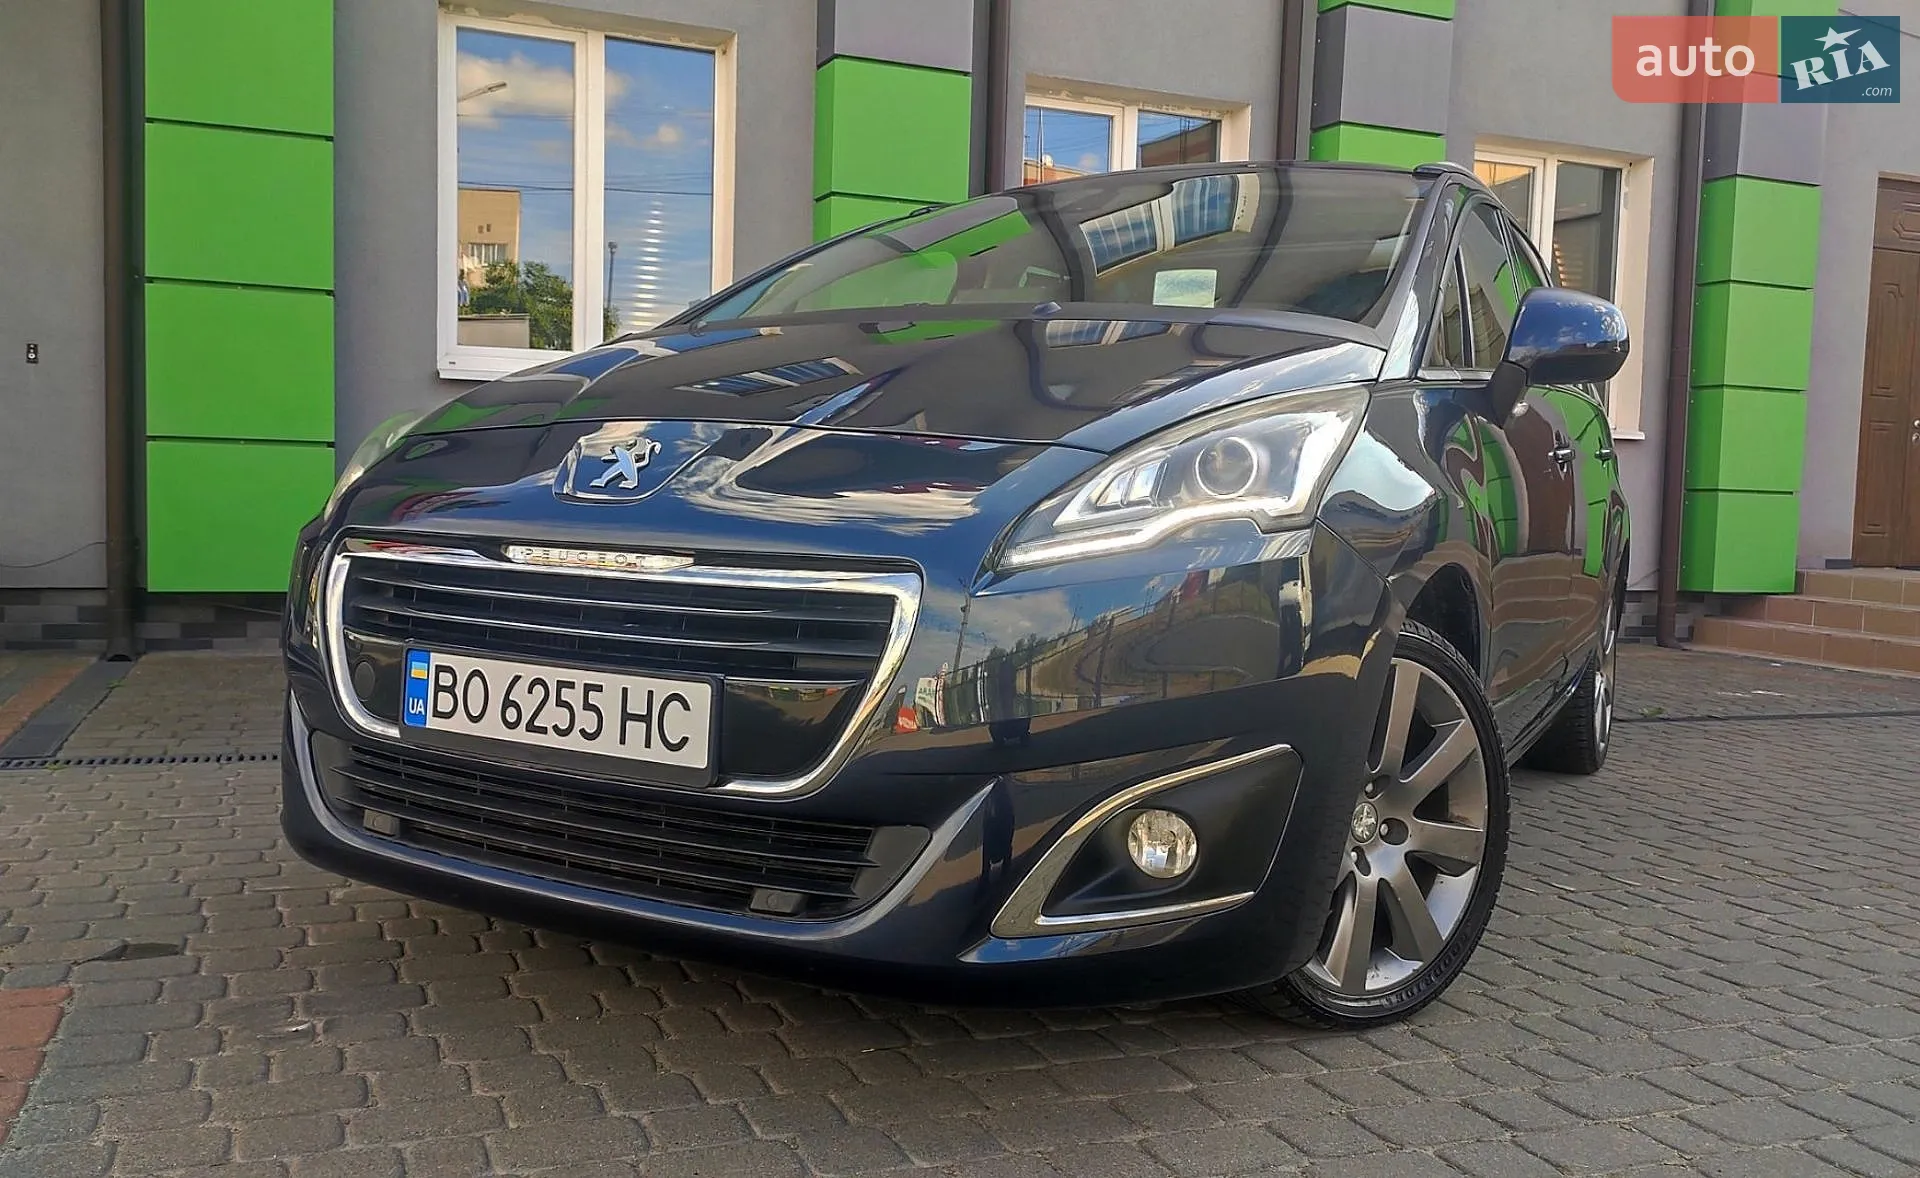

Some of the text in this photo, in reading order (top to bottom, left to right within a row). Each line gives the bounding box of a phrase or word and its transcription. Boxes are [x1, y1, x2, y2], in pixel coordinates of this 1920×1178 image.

[409, 697, 425, 715] UA
[432, 664, 691, 752] BO 6255 HC
